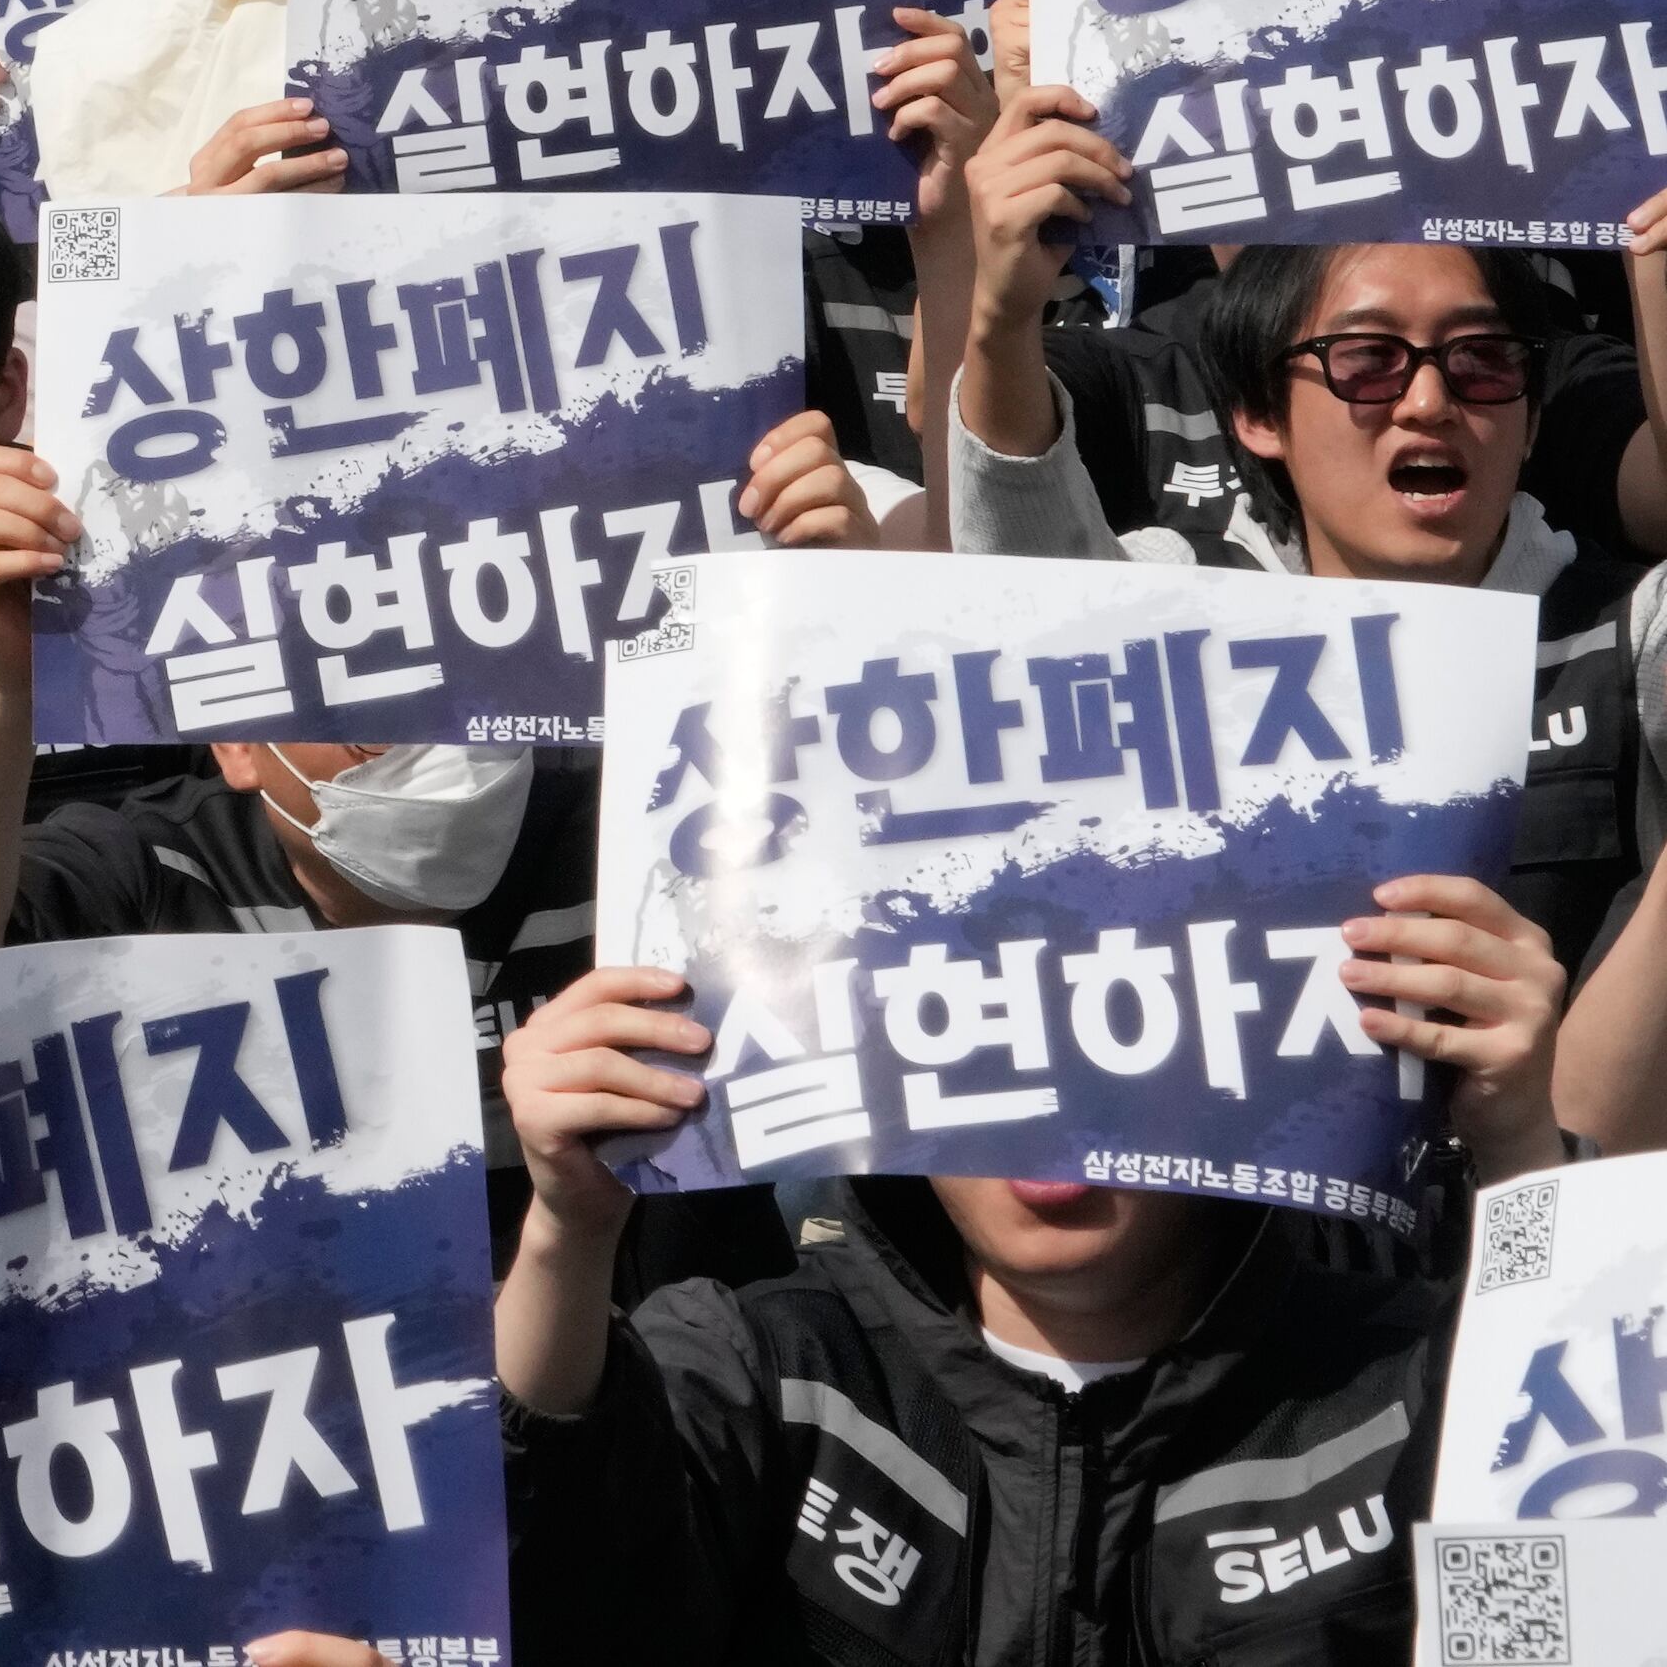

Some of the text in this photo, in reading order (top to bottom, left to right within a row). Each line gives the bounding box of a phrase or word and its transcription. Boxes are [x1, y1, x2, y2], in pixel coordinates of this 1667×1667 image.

[378, 6, 870, 195] 실현하자
[1134, 24, 1667, 235] 실현하자
[1422, 216, 1590, 245] 삼성전자노동조합
[82, 222, 711, 485] 상한폐지
[645, 611, 1404, 878] 상한폐지
[701, 919, 1428, 1170] 실현하자
[1083, 1150, 1416, 1236] 삼성전자노동조합 공동투쟁본부
[1207, 1494, 1393, 1606] SELU
